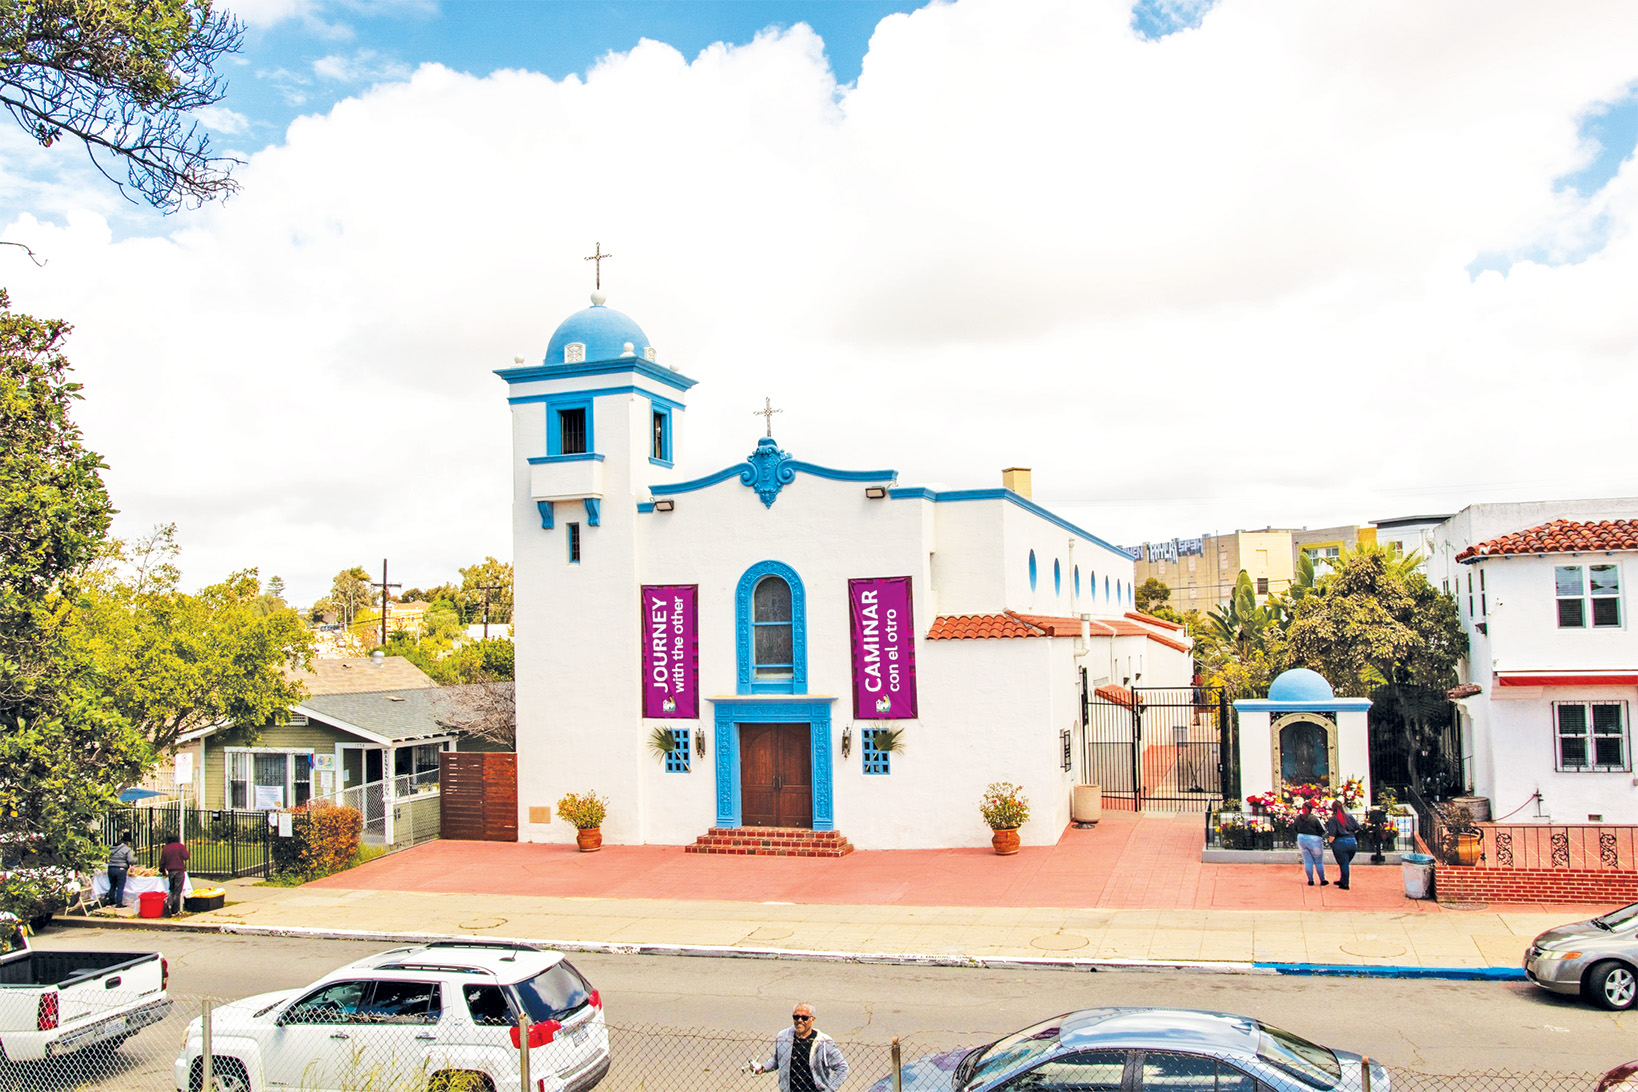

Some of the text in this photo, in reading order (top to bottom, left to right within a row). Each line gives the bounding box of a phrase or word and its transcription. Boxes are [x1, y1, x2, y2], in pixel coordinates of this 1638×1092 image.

[652, 596, 668, 693] JOURNEY
[670, 596, 685, 693] with the other
[861, 590, 882, 692] CAMINAR
[884, 609, 900, 692] con el otro
